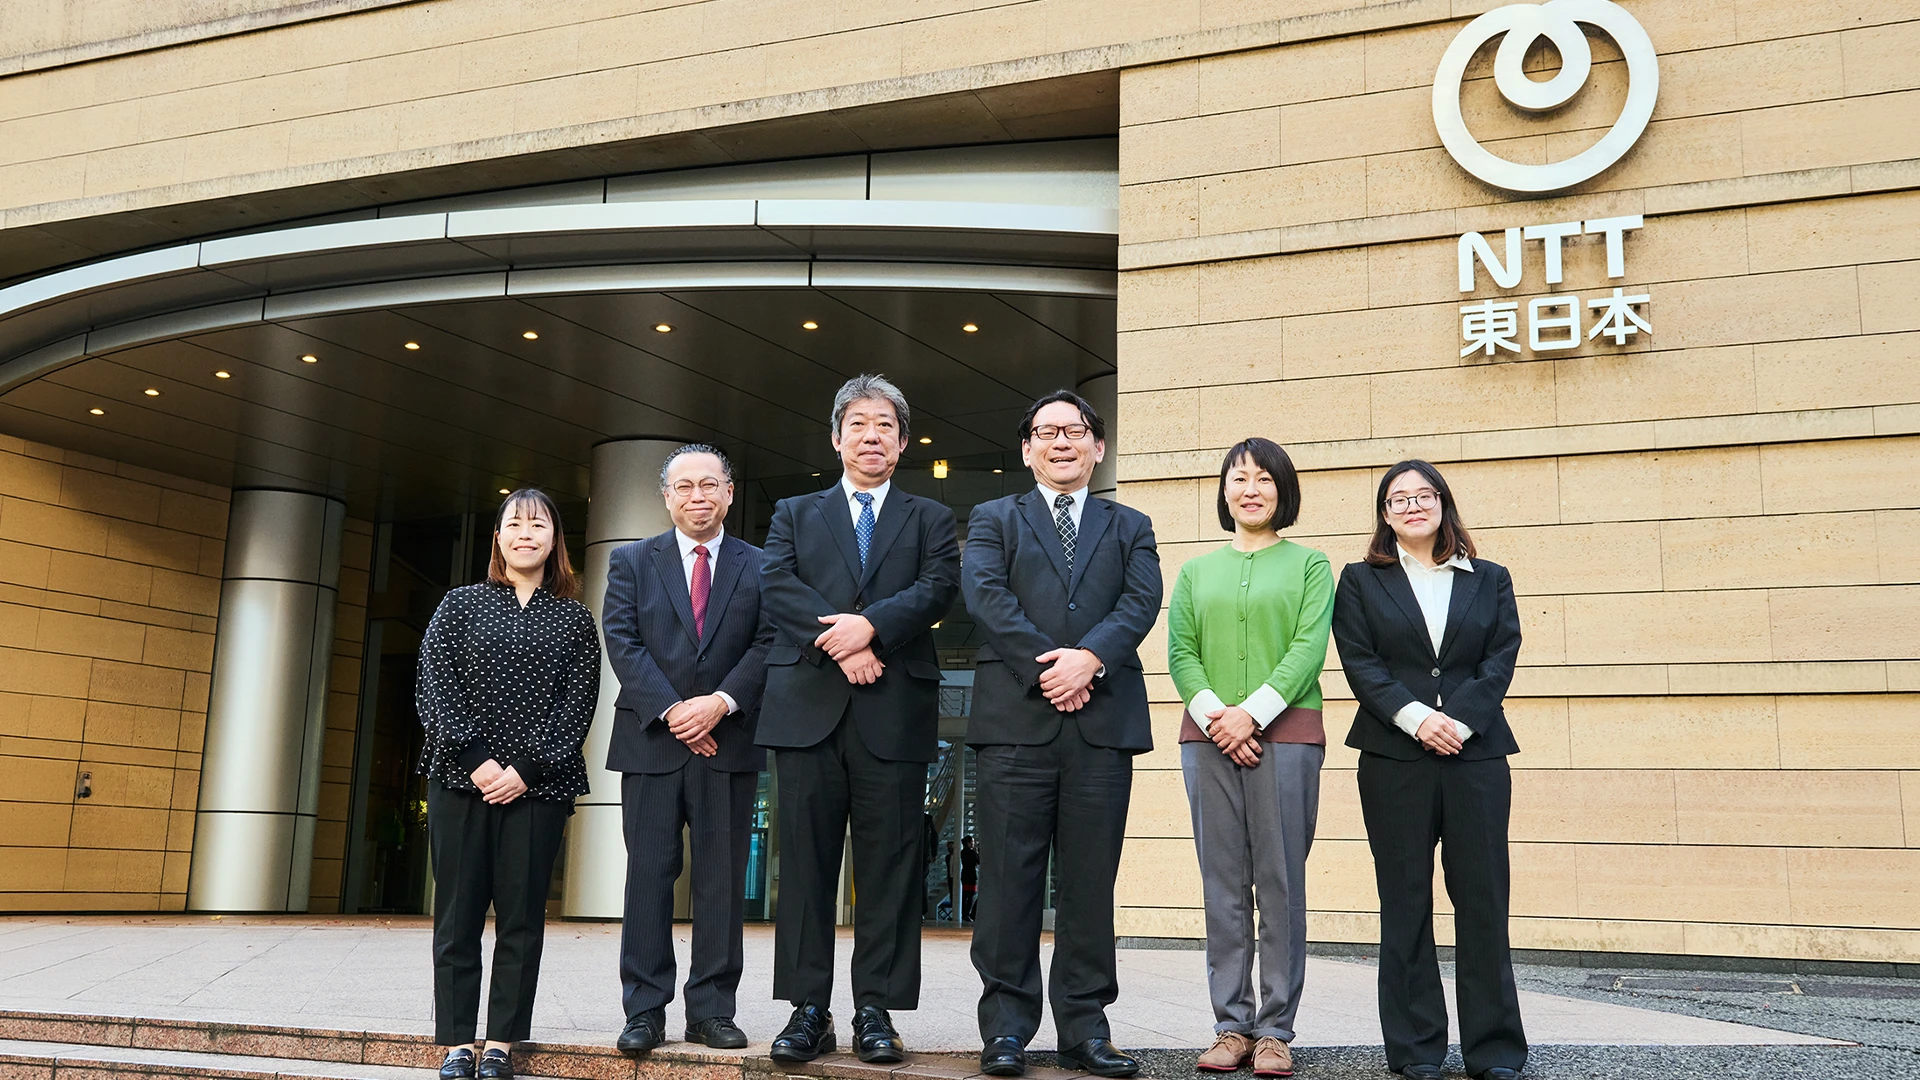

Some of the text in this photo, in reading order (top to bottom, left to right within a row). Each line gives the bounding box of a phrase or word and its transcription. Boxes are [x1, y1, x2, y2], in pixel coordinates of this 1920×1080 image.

[1457, 214, 1644, 293] NTT
[1459, 287, 1653, 358] 東日本
